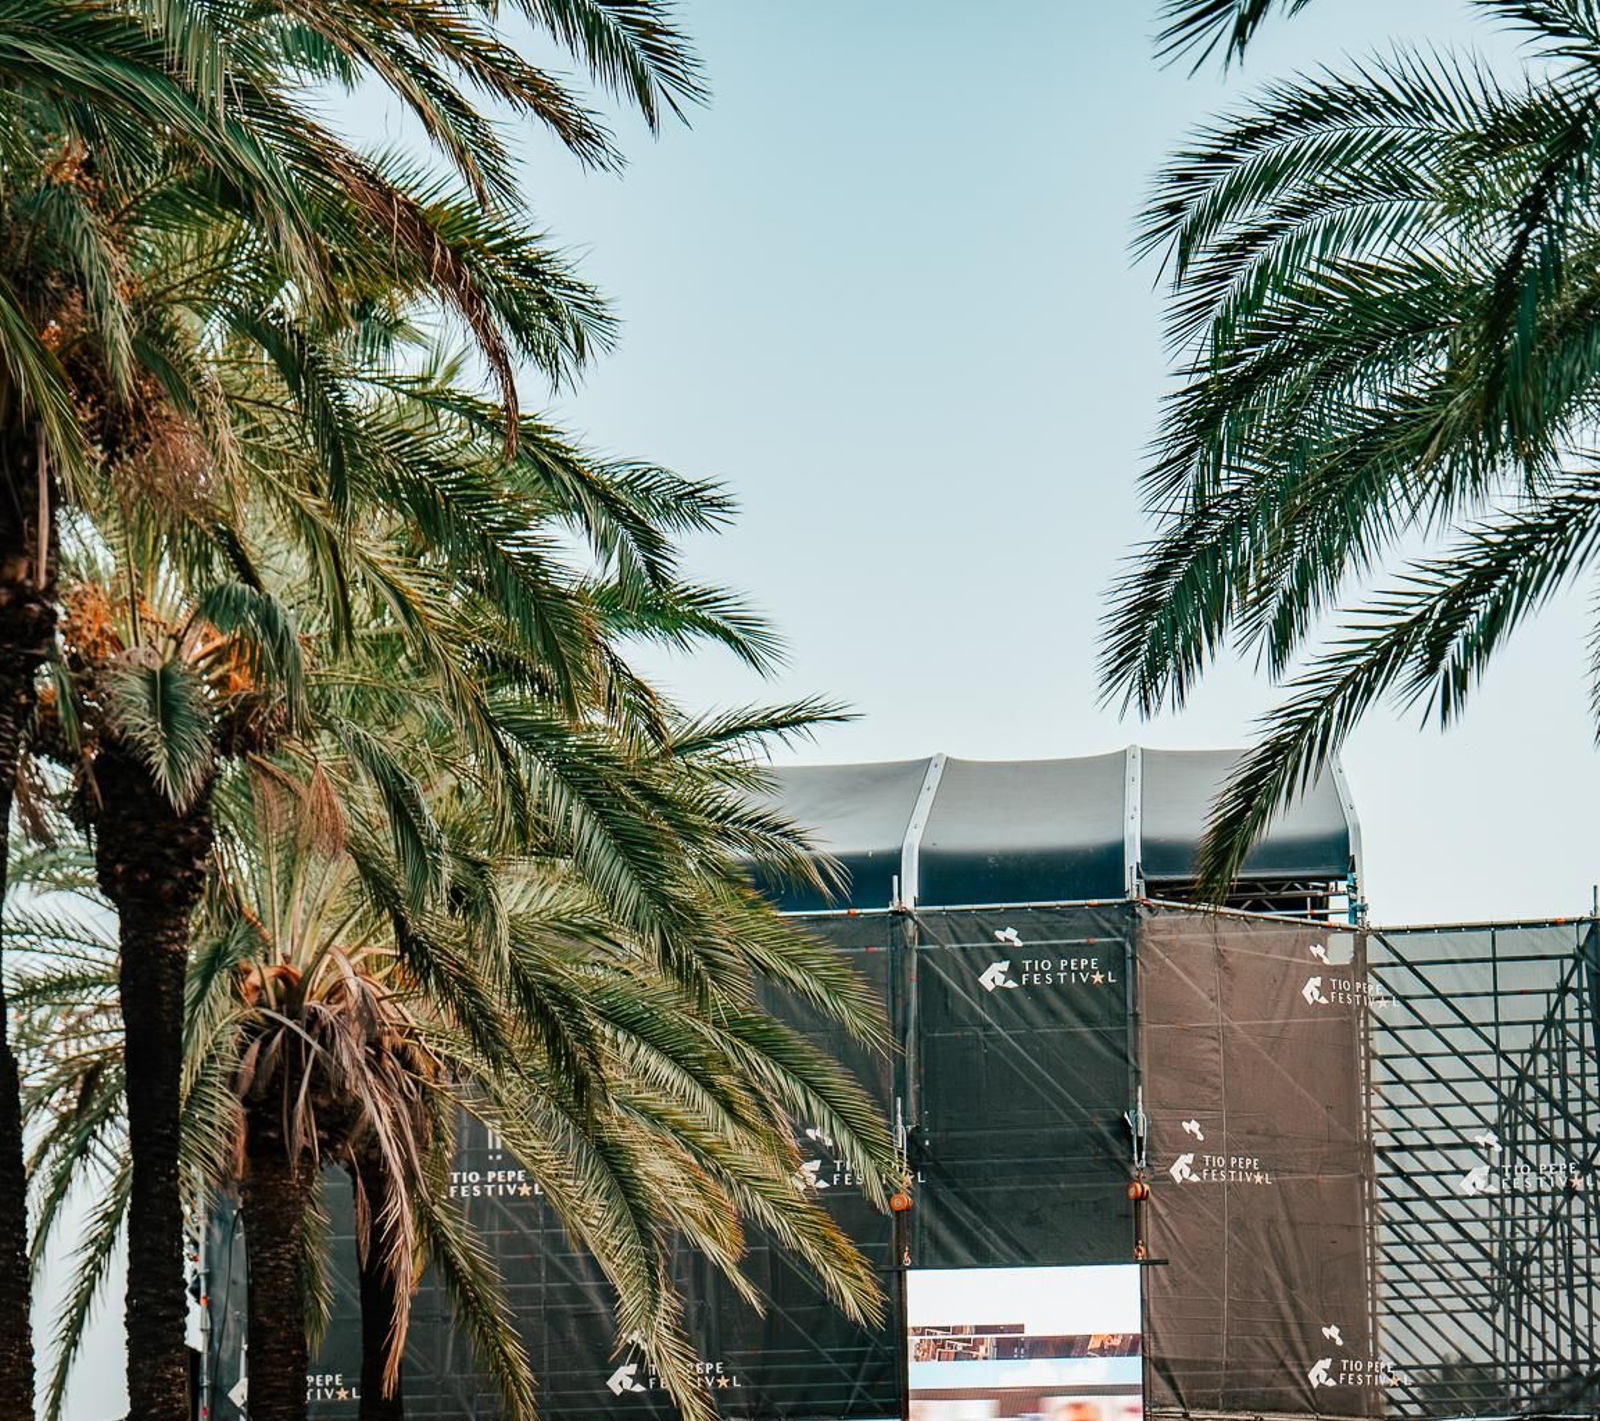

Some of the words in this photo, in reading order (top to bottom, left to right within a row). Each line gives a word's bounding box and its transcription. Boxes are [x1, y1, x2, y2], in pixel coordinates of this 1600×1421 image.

[1022, 959, 1051, 971] TIO
[1060, 958, 1099, 970] PEPE
[1330, 978, 1351, 992] TIO
[1355, 981, 1383, 995] PEPE
[1202, 1155, 1225, 1168] TIO
[1231, 1156, 1260, 1170] PEPE
[1502, 1163, 1531, 1177] TIO
[1540, 1162, 1577, 1175] PEPE
[451, 1171, 480, 1184] TIO
[487, 1170, 526, 1183] PEPE
[1341, 1359, 1362, 1372] TIO
[306, 1374, 343, 1387] PEPE
